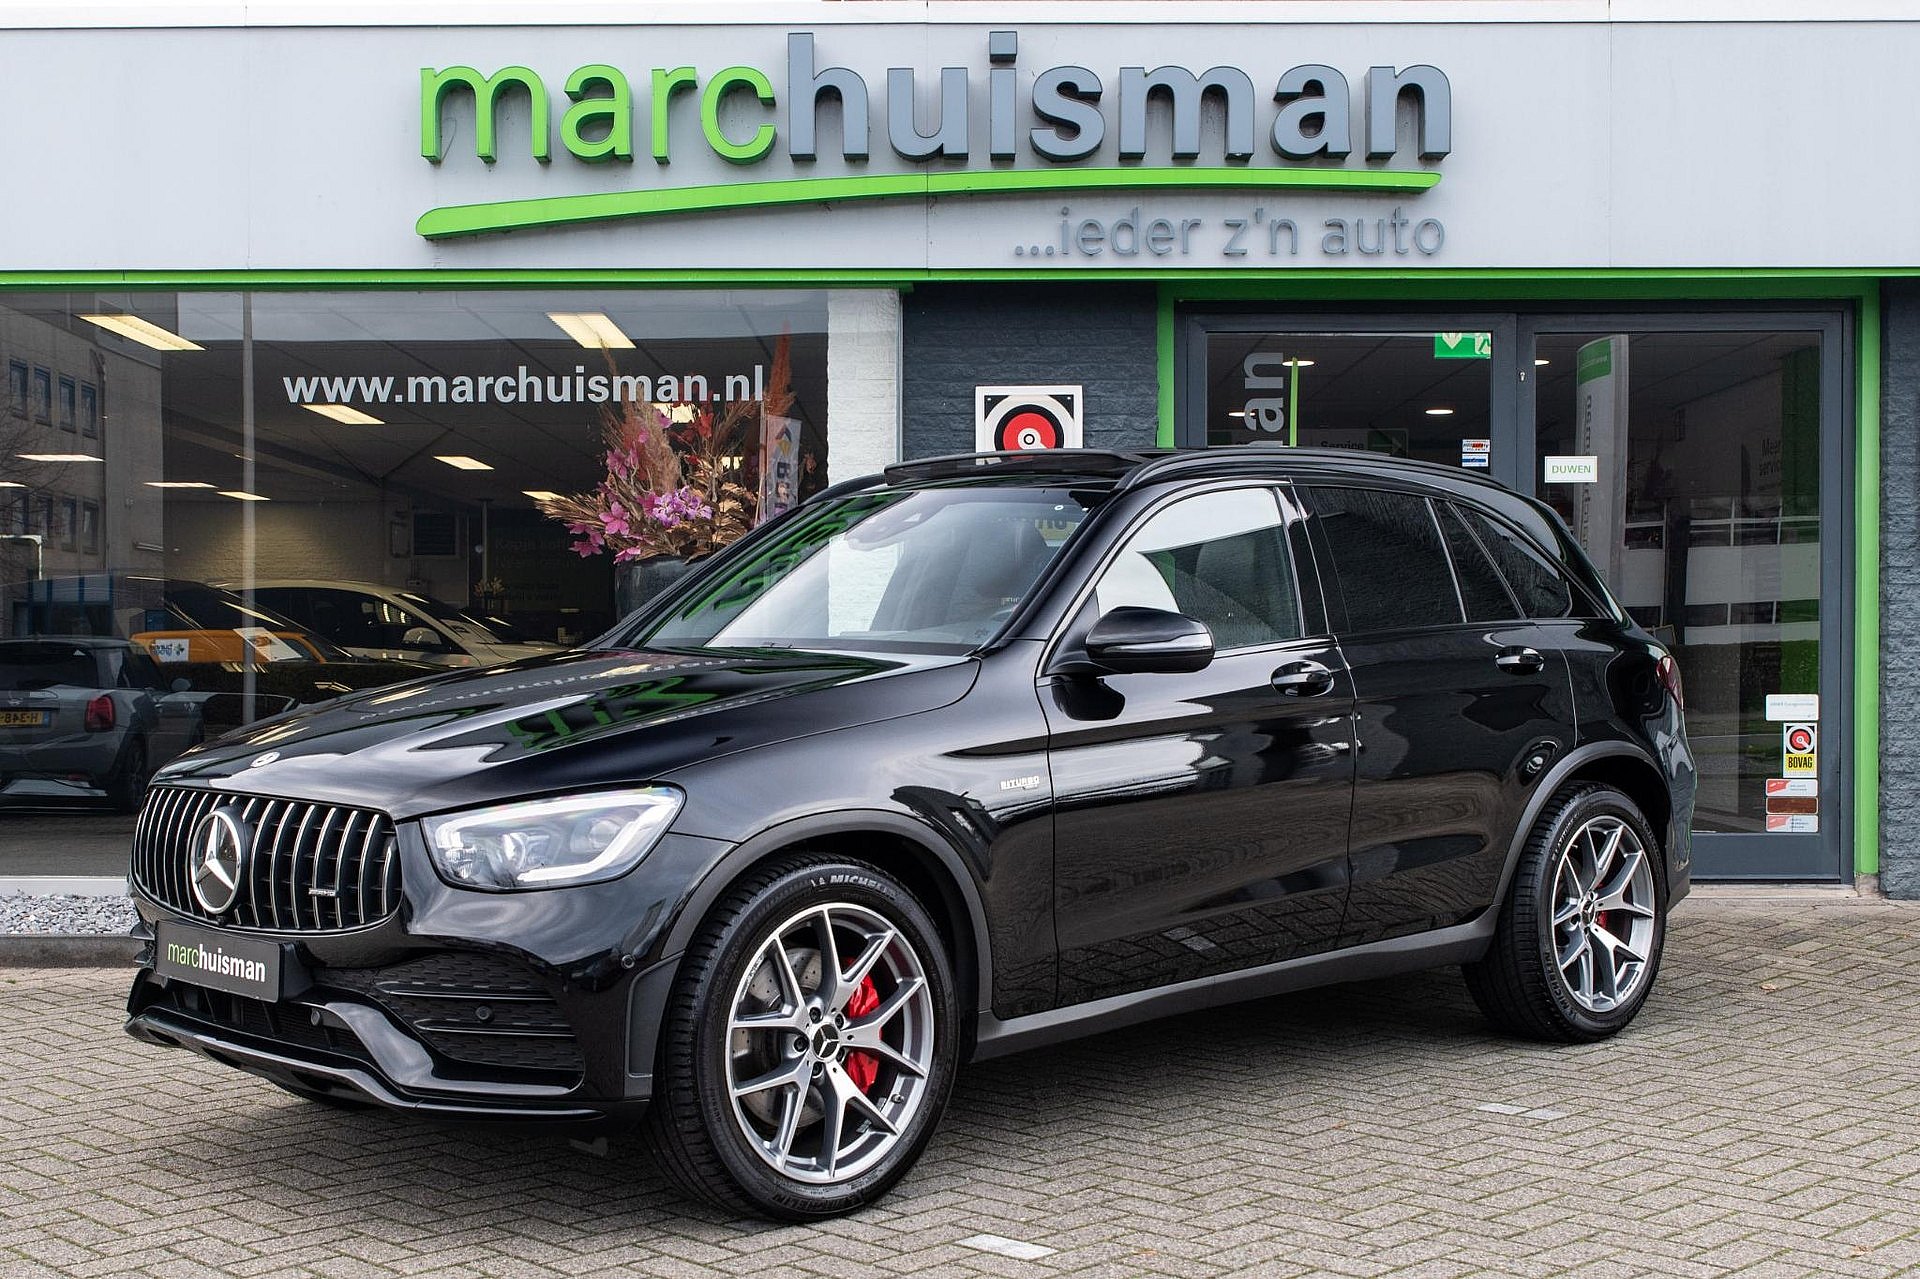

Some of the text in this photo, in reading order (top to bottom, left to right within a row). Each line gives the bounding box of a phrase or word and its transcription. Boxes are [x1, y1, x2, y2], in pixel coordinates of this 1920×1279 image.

[420, 31, 1452, 164] marchuisman
[1014, 206, 1446, 257] ...ieder z'n auto
[282, 364, 764, 403] www.marchuisman.nl
[1551, 464, 1592, 475] DUWEN
[1788, 756, 1813, 768] BOVAG
[830, 874, 897, 899] MICHELIN
[167, 943, 266, 983] marchuisman
[1544, 951, 1571, 1011] MICHELIN
